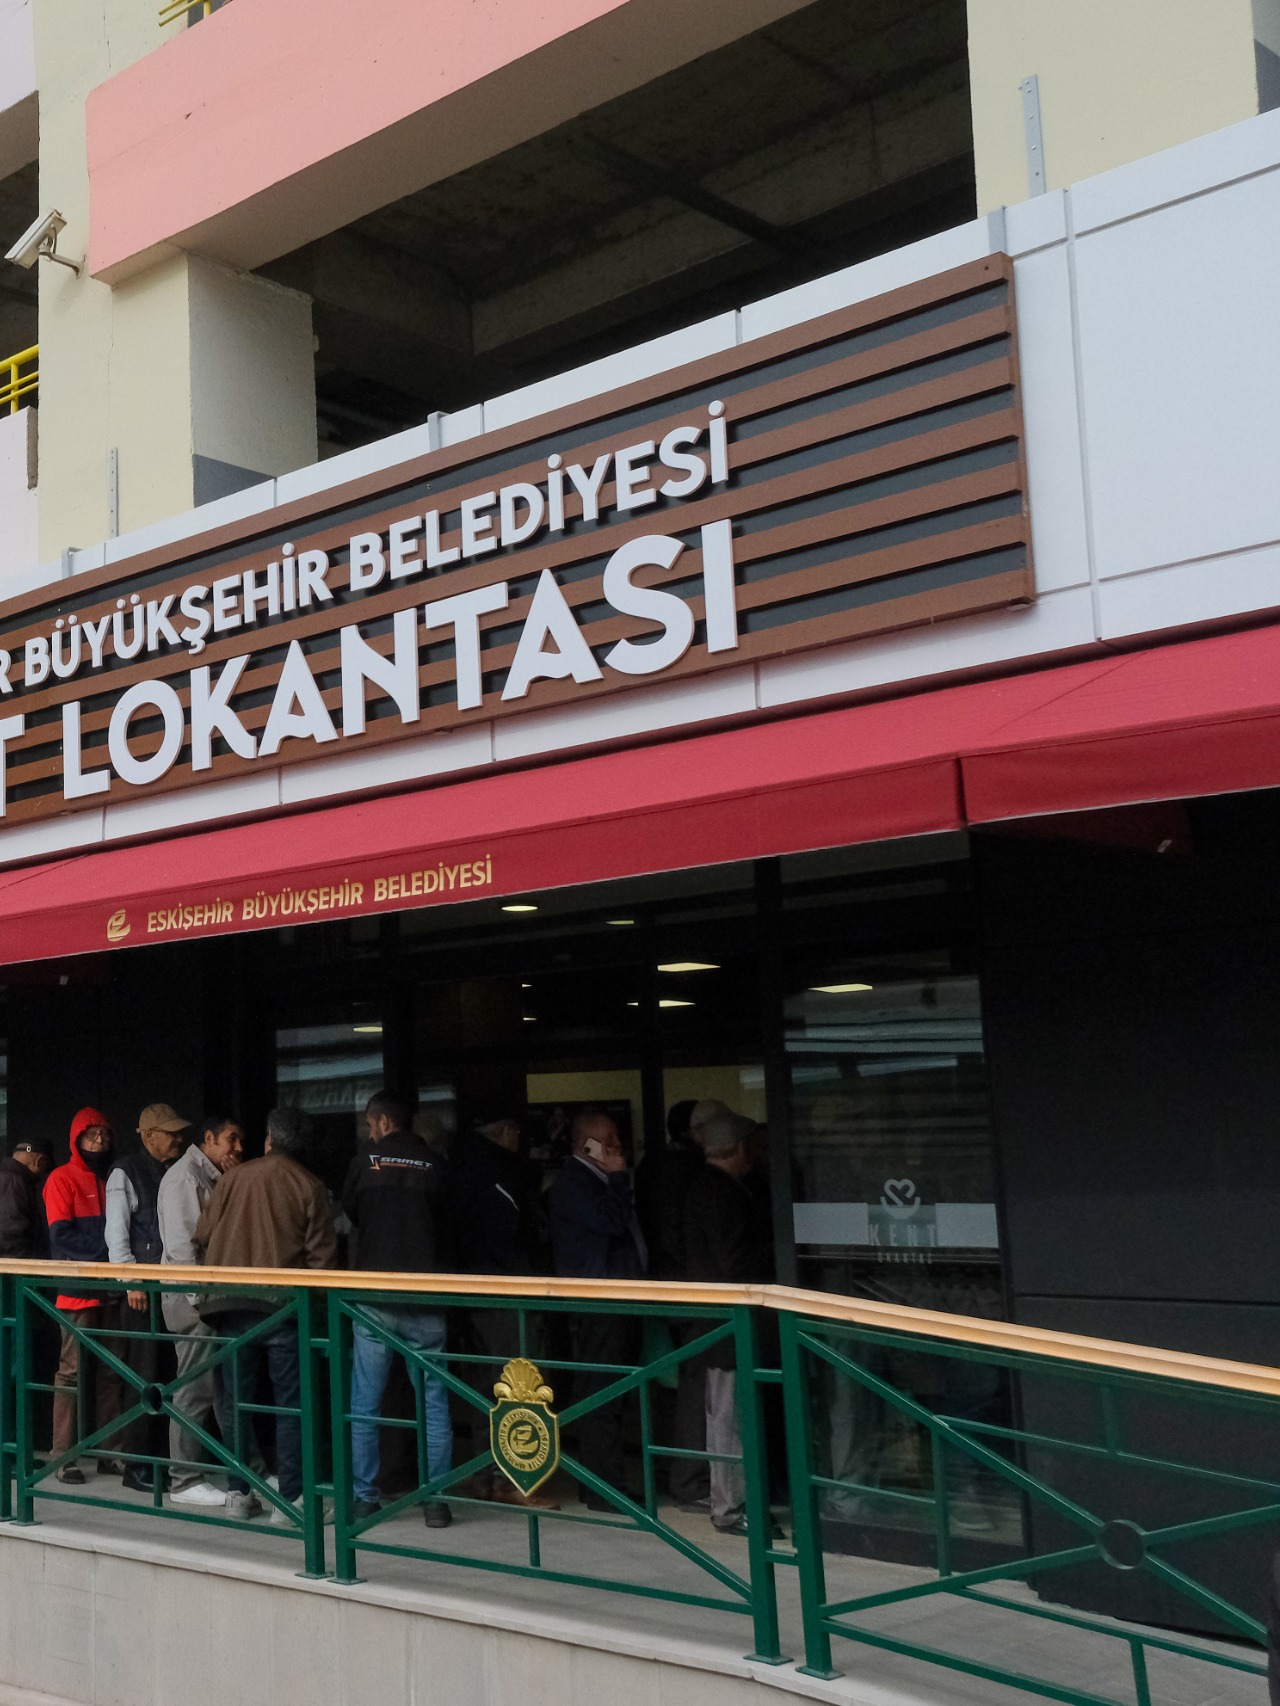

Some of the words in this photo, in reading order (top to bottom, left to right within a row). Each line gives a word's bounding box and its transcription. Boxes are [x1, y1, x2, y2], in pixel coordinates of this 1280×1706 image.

[24, 543, 334, 687] BÜYÜKŞEHİR
[349, 399, 729, 592] BELEDİYESİ
[62, 519, 739, 800] LOKANTASI
[146, 898, 233, 933] ESKİŞEHİR
[241, 878, 364, 921] BÜYÜKŞEHİR
[373, 853, 493, 902] BELEDİYESİ
[869, 1223, 936, 1247] KENT
